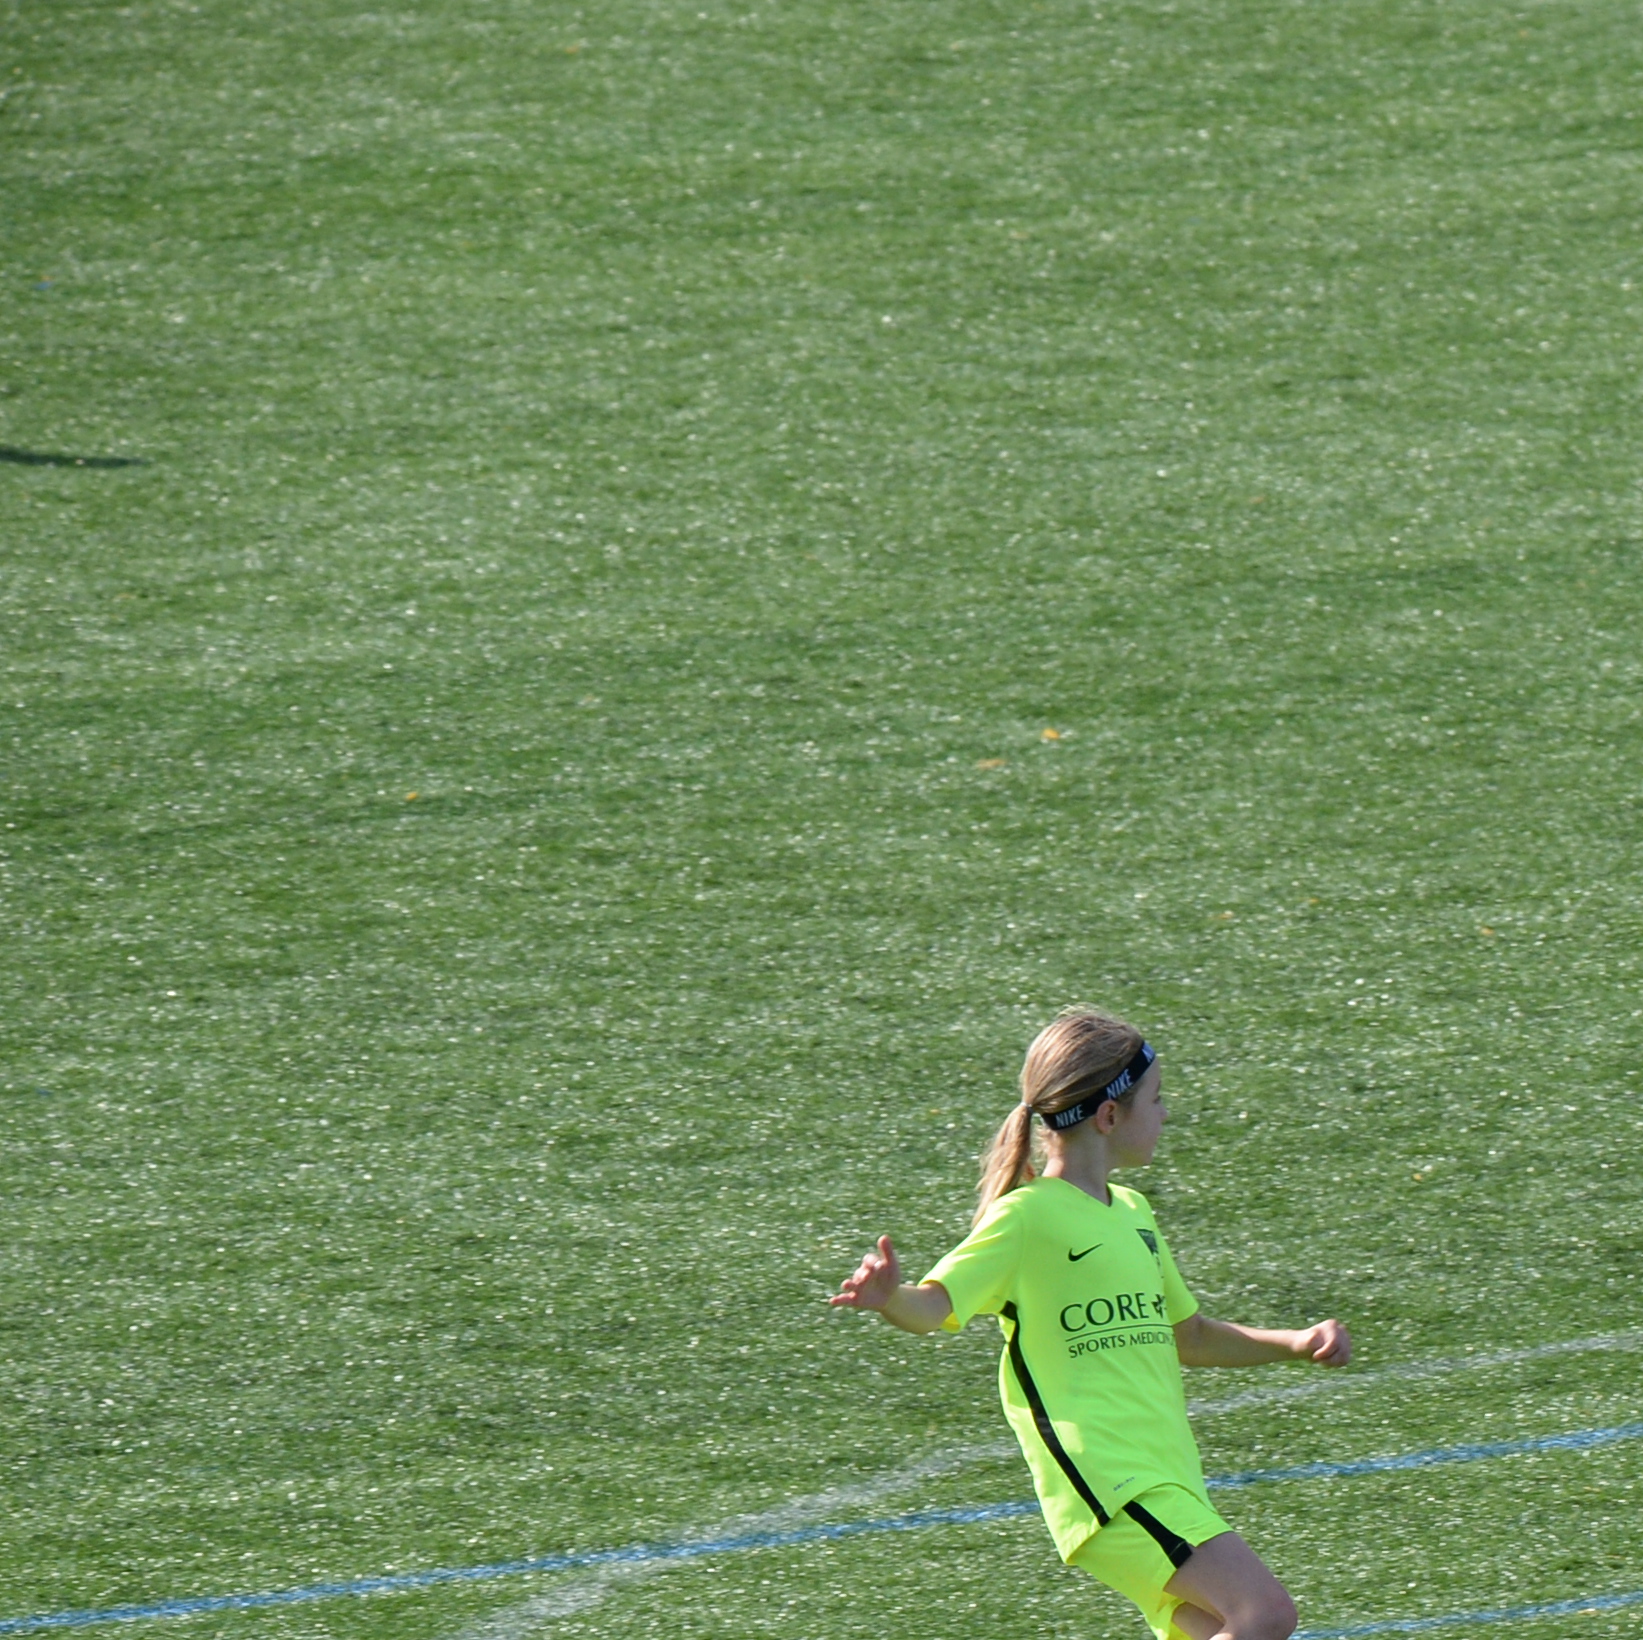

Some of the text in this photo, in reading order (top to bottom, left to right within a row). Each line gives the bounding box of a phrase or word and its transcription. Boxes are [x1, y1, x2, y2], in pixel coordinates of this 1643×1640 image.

[1105, 1068, 1134, 1101] NIKE
[1055, 1104, 1085, 1128] NIKE
[1060, 1292, 1150, 1333] CORE
[1068, 1334, 1127, 1359] SPORTS
